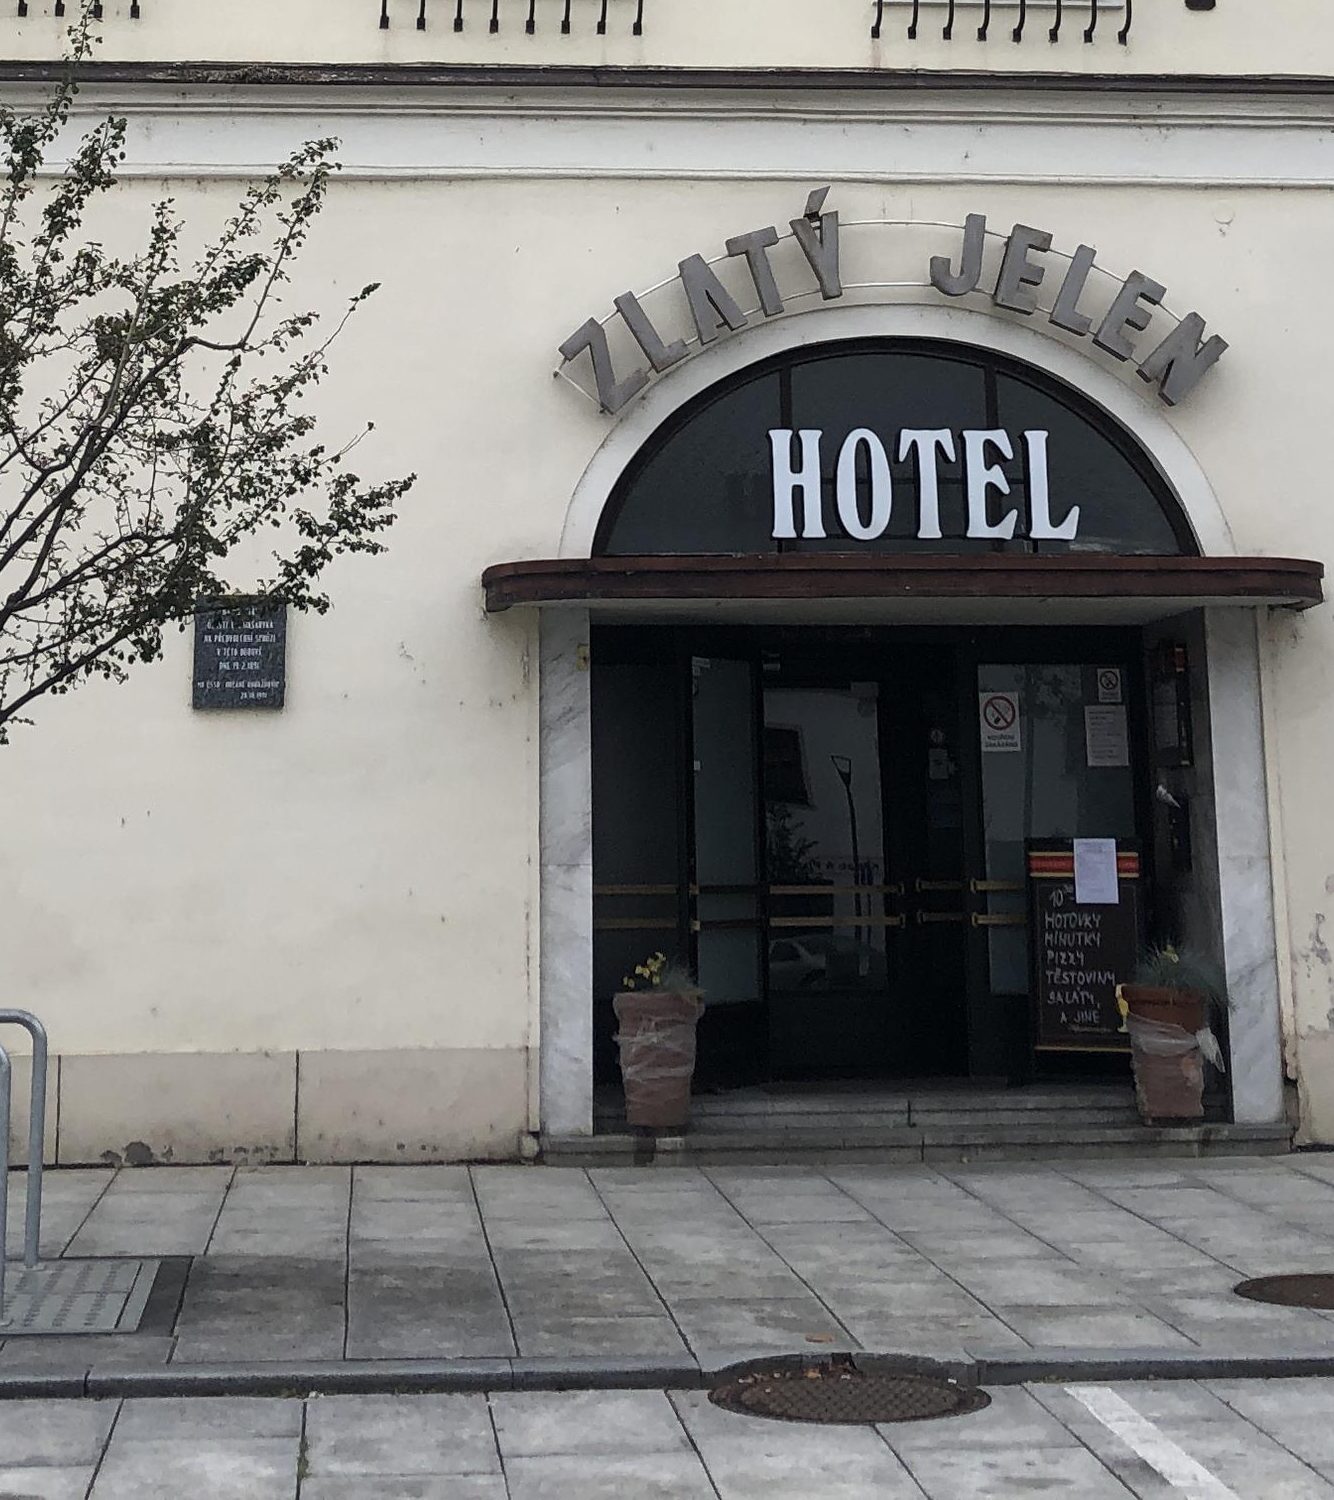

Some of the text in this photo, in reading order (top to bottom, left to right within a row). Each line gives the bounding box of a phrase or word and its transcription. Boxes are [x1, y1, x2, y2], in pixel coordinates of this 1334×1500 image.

[557, 186, 1229, 414] ZLATÝ JELEN
[768, 427, 1080, 540] HOTEL
[1045, 911, 1101, 929] HOTOVKY
[1047, 949, 1084, 966] PIZZY
